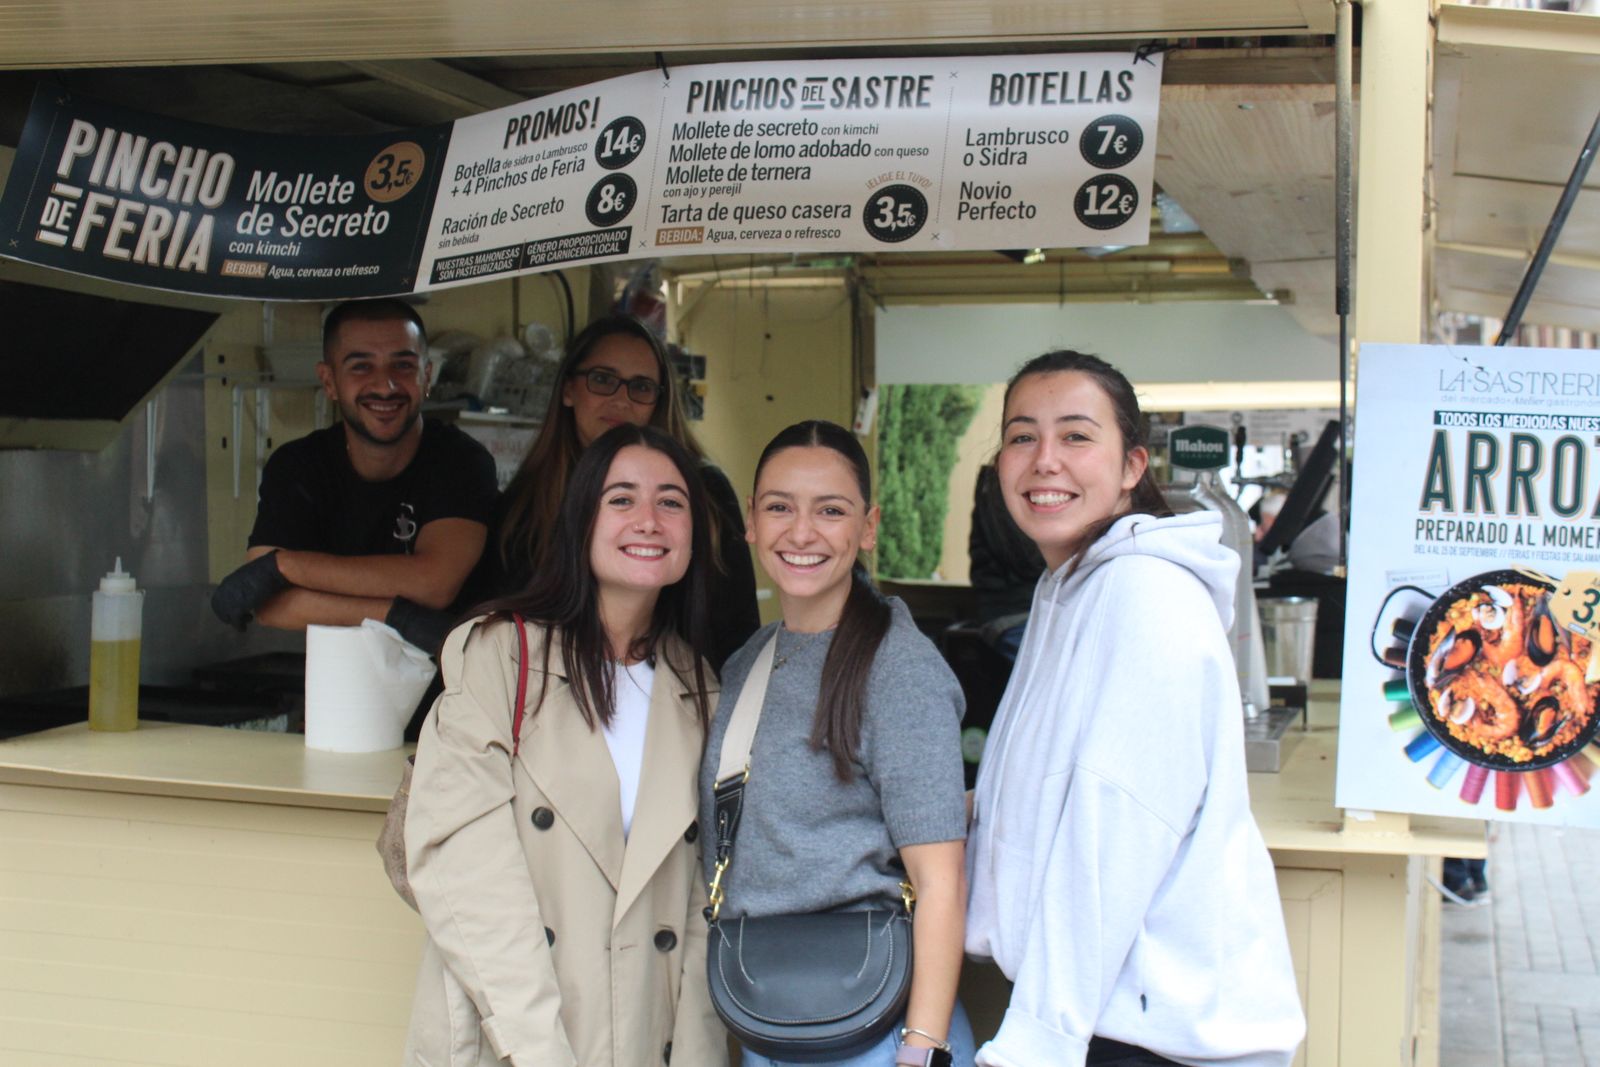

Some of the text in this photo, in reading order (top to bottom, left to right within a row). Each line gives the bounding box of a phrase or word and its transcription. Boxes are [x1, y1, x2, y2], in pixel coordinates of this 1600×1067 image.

[686, 74, 934, 113] PINCHOS DEL SASTRE
[989, 70, 1134, 106] BOTELLAS
[503, 96, 601, 149] PROMOS!
[672, 119, 879, 141] Mollete de secreto con kimchi
[600, 126, 641, 159] 14€
[966, 127, 1069, 146] Lambrusco
[1097, 125, 1128, 155] 7€
[454, 142, 588, 182] Botella de sidra o Lambrusco
[669, 139, 929, 163] Mollete de lomo adobado con queso
[963, 147, 1028, 167] o Sidra
[57, 119, 236, 209] PINCHO
[665, 163, 811, 185] Mollete de ternera
[895, 171, 905, 180] EL
[247, 170, 355, 205] Mollete
[450, 157, 586, 198] + 4 Pinchos de Feria
[597, 184, 626, 214] 8€
[663, 183, 742, 199] con ajo y perejil
[959, 181, 1012, 200] Novio
[1083, 184, 1133, 216] 12€
[236, 205, 390, 238] de Secreto
[441, 197, 565, 236] Ración de Secreto
[661, 202, 852, 225] Tarta de queso casera
[874, 195, 916, 232] 3,5€
[957, 200, 1037, 220] Perfecto
[40, 190, 215, 273] DE FERIA
[438, 233, 480, 249] sin bebida
[527, 230, 628, 256] GÉNERO PROPORCIONADO
[658, 226, 841, 244] BEBIDA: Agua, cerveza o refresco
[229, 239, 301, 257] con kimchi
[436, 247, 520, 271] NUESTRAS MAHONESAS
[529, 252, 547, 265] POR
[594, 242, 620, 256] LOCAL
[268, 264, 295, 279] Agua,
[297, 266, 332, 278] cerveza
[334, 267, 341, 276] o
[342, 264, 380, 276] refresco
[439, 258, 513, 281] SON PASTEURIZADAS
[1439, 412, 1477, 426] TODOS
[1479, 414, 1501, 427] LOS
[1503, 414, 1567, 430] MEDIODÍAS
[1175, 439, 1223, 452] Mahou
[1419, 429, 1600, 520] ARRO
[1415, 519, 1600, 549] PREPARADO AL MOME
